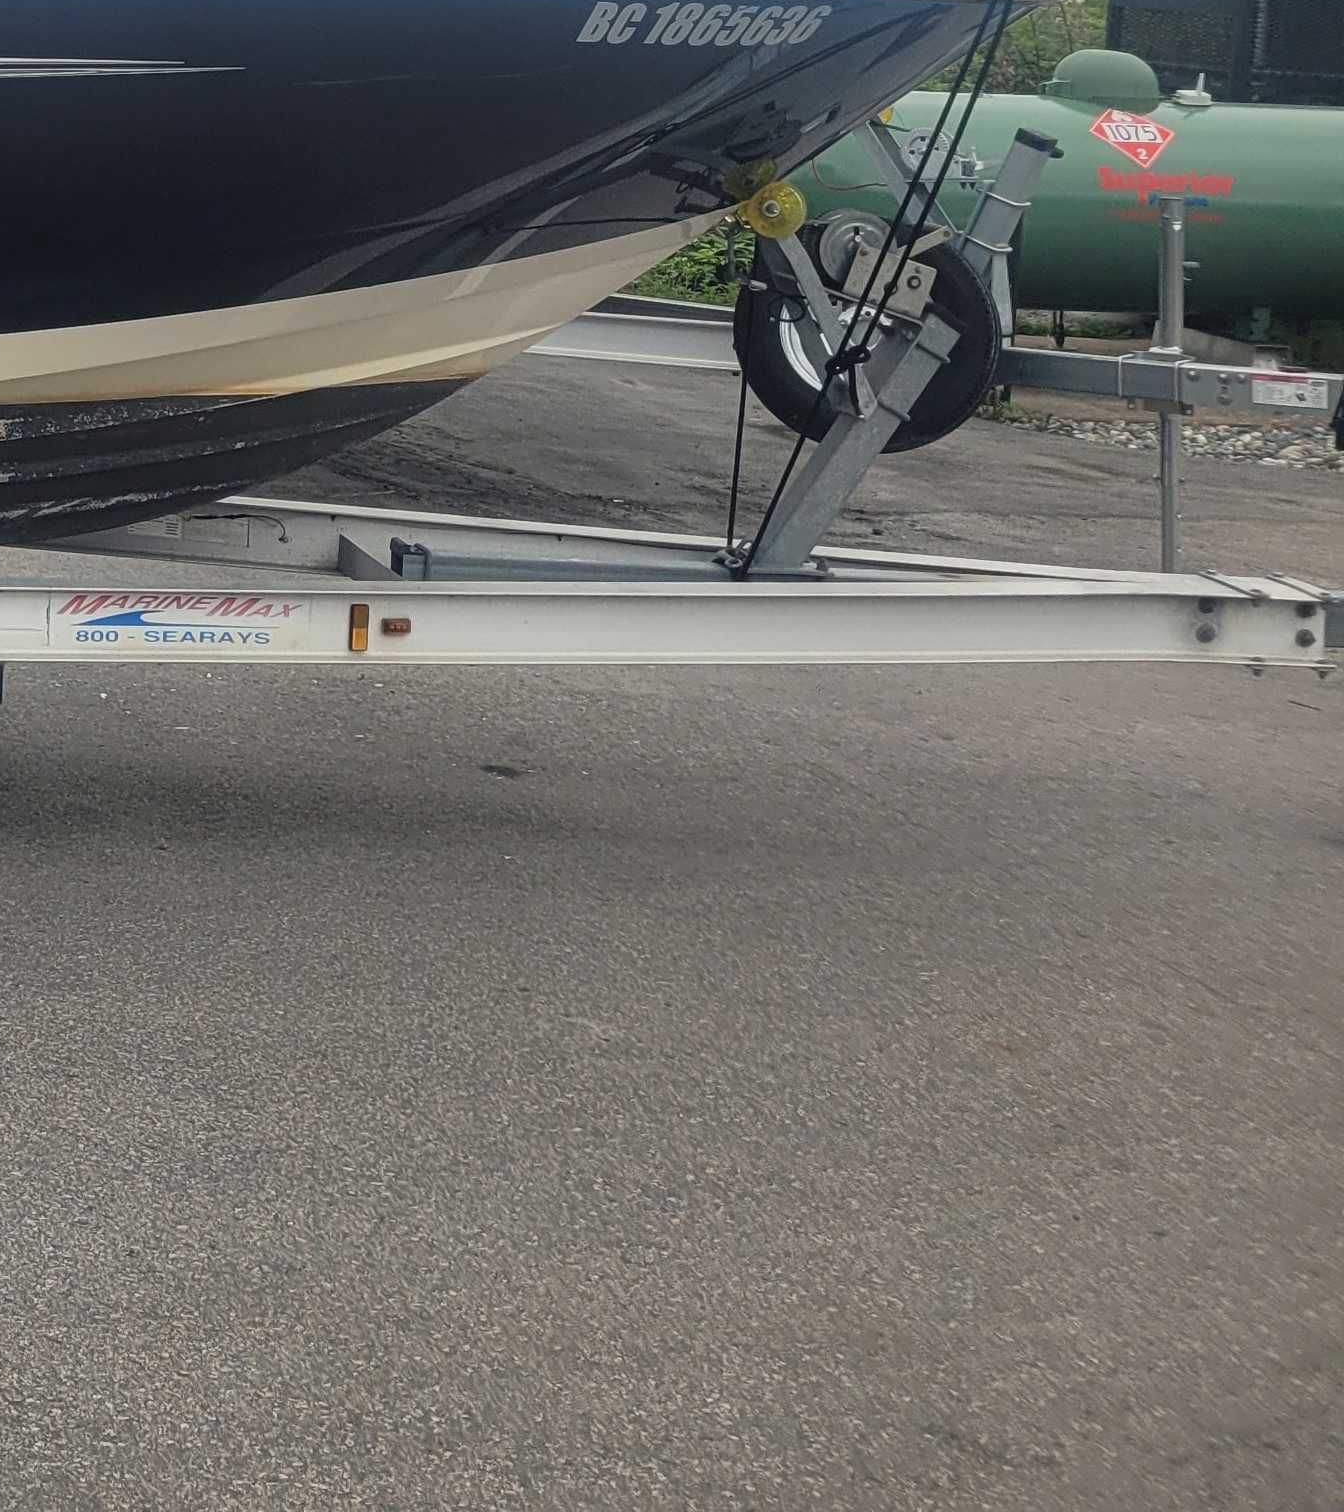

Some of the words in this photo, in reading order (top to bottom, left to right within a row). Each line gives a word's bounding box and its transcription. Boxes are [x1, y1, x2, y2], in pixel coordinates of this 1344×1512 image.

[575, 1, 648, 45] BC
[643, 1, 833, 47] 1865636
[1105, 124, 1158, 141] 1075
[1136, 147, 1149, 160] 2
[1097, 167, 1234, 204] Superior
[75, 630, 119, 643] 800
[143, 630, 271, 645] SEARAYS
